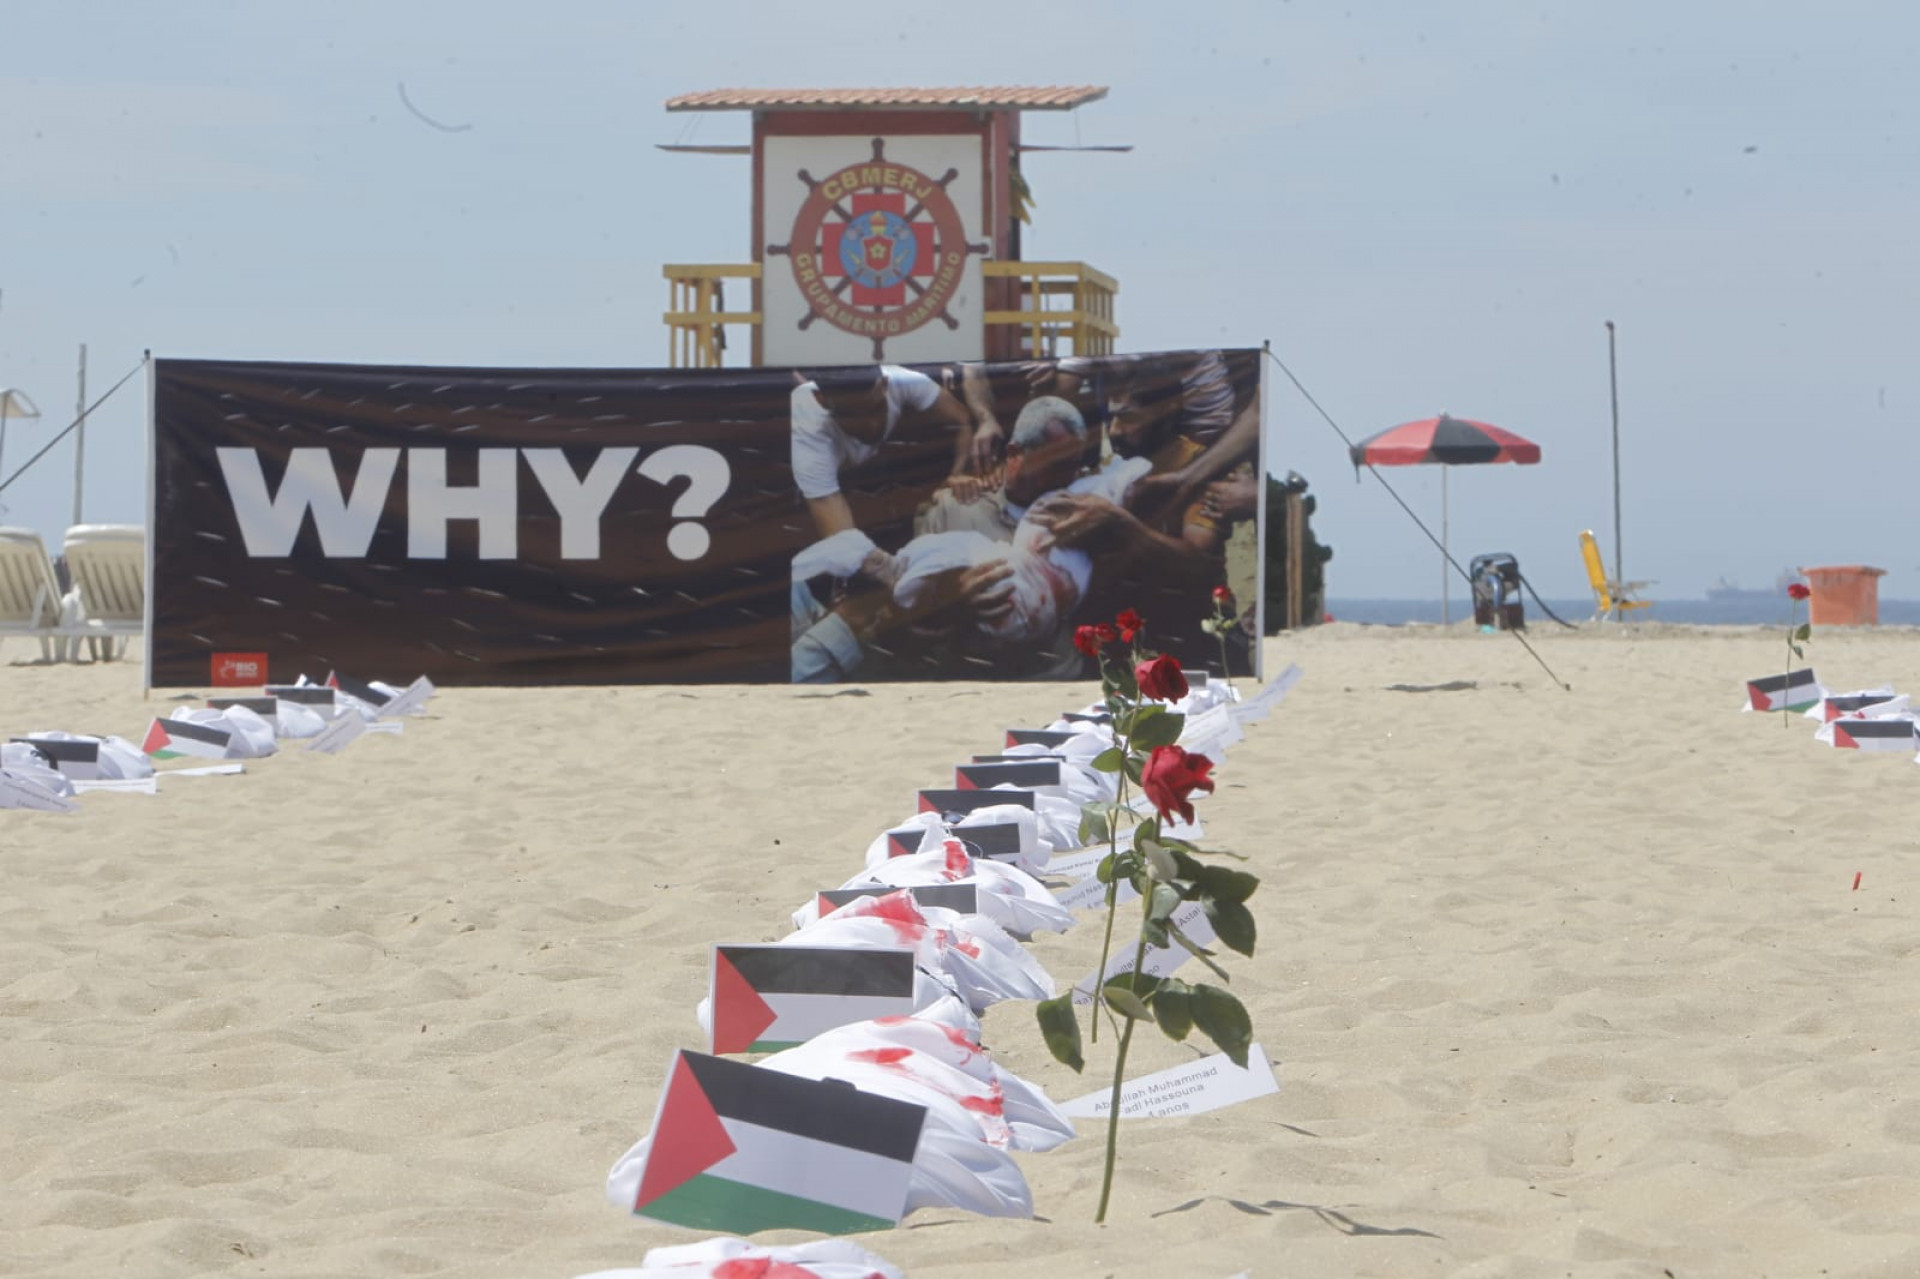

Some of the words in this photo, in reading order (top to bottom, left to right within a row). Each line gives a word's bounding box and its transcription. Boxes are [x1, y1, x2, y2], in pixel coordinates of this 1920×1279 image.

[821, 166, 932, 200] CBMERJ
[796, 253, 901, 333] GRUPAMENTO
[215, 444, 732, 561] WHY?
[1094, 1089, 1146, 1112] Abllah
[1148, 1066, 1218, 1094] Muhammad
